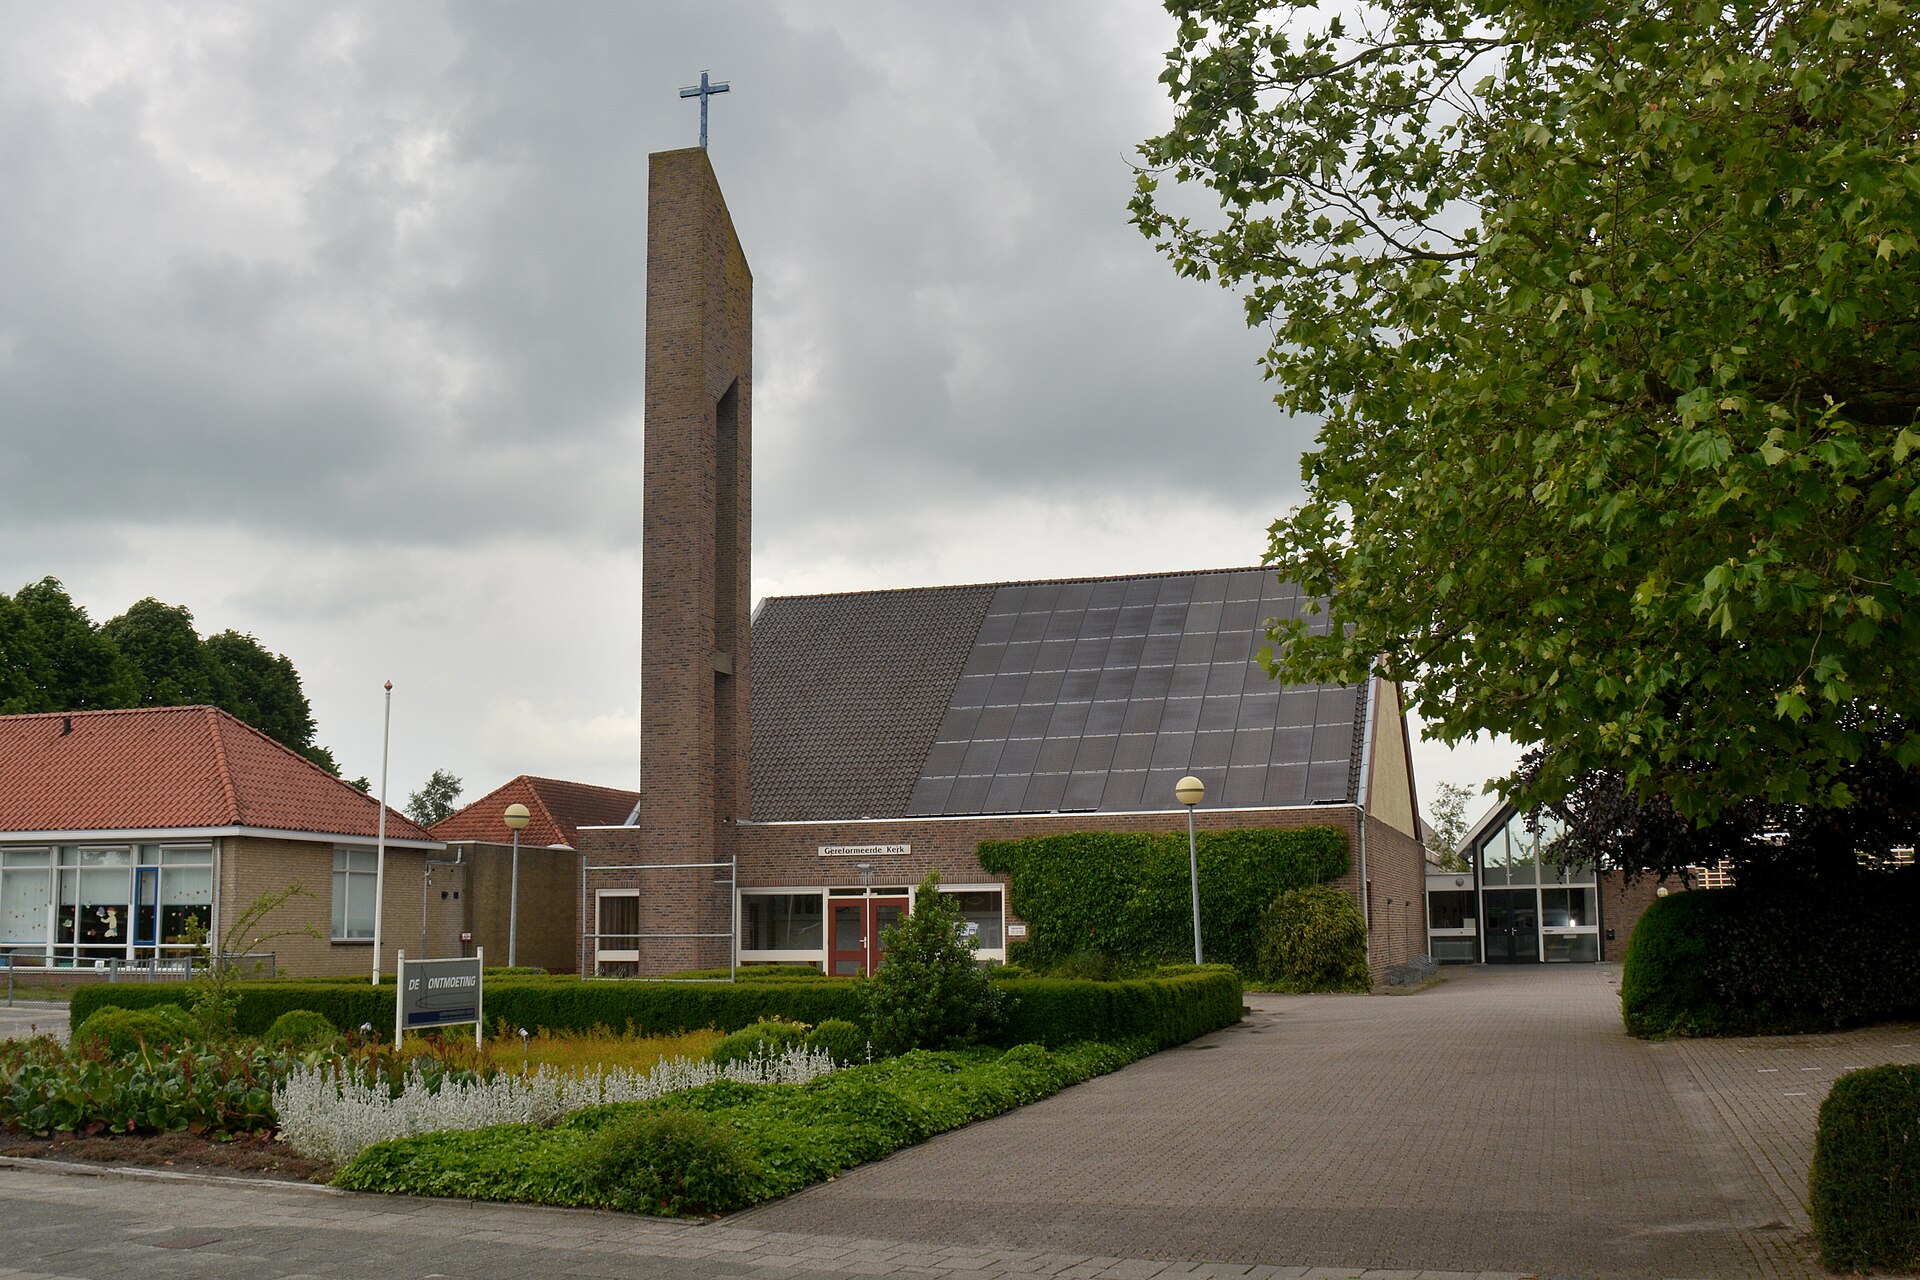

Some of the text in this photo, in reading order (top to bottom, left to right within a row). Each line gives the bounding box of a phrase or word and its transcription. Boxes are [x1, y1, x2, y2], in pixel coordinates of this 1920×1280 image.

[824, 846, 882, 854] Gereformeerde
[408, 975, 476, 991] DE ONTMOETING
